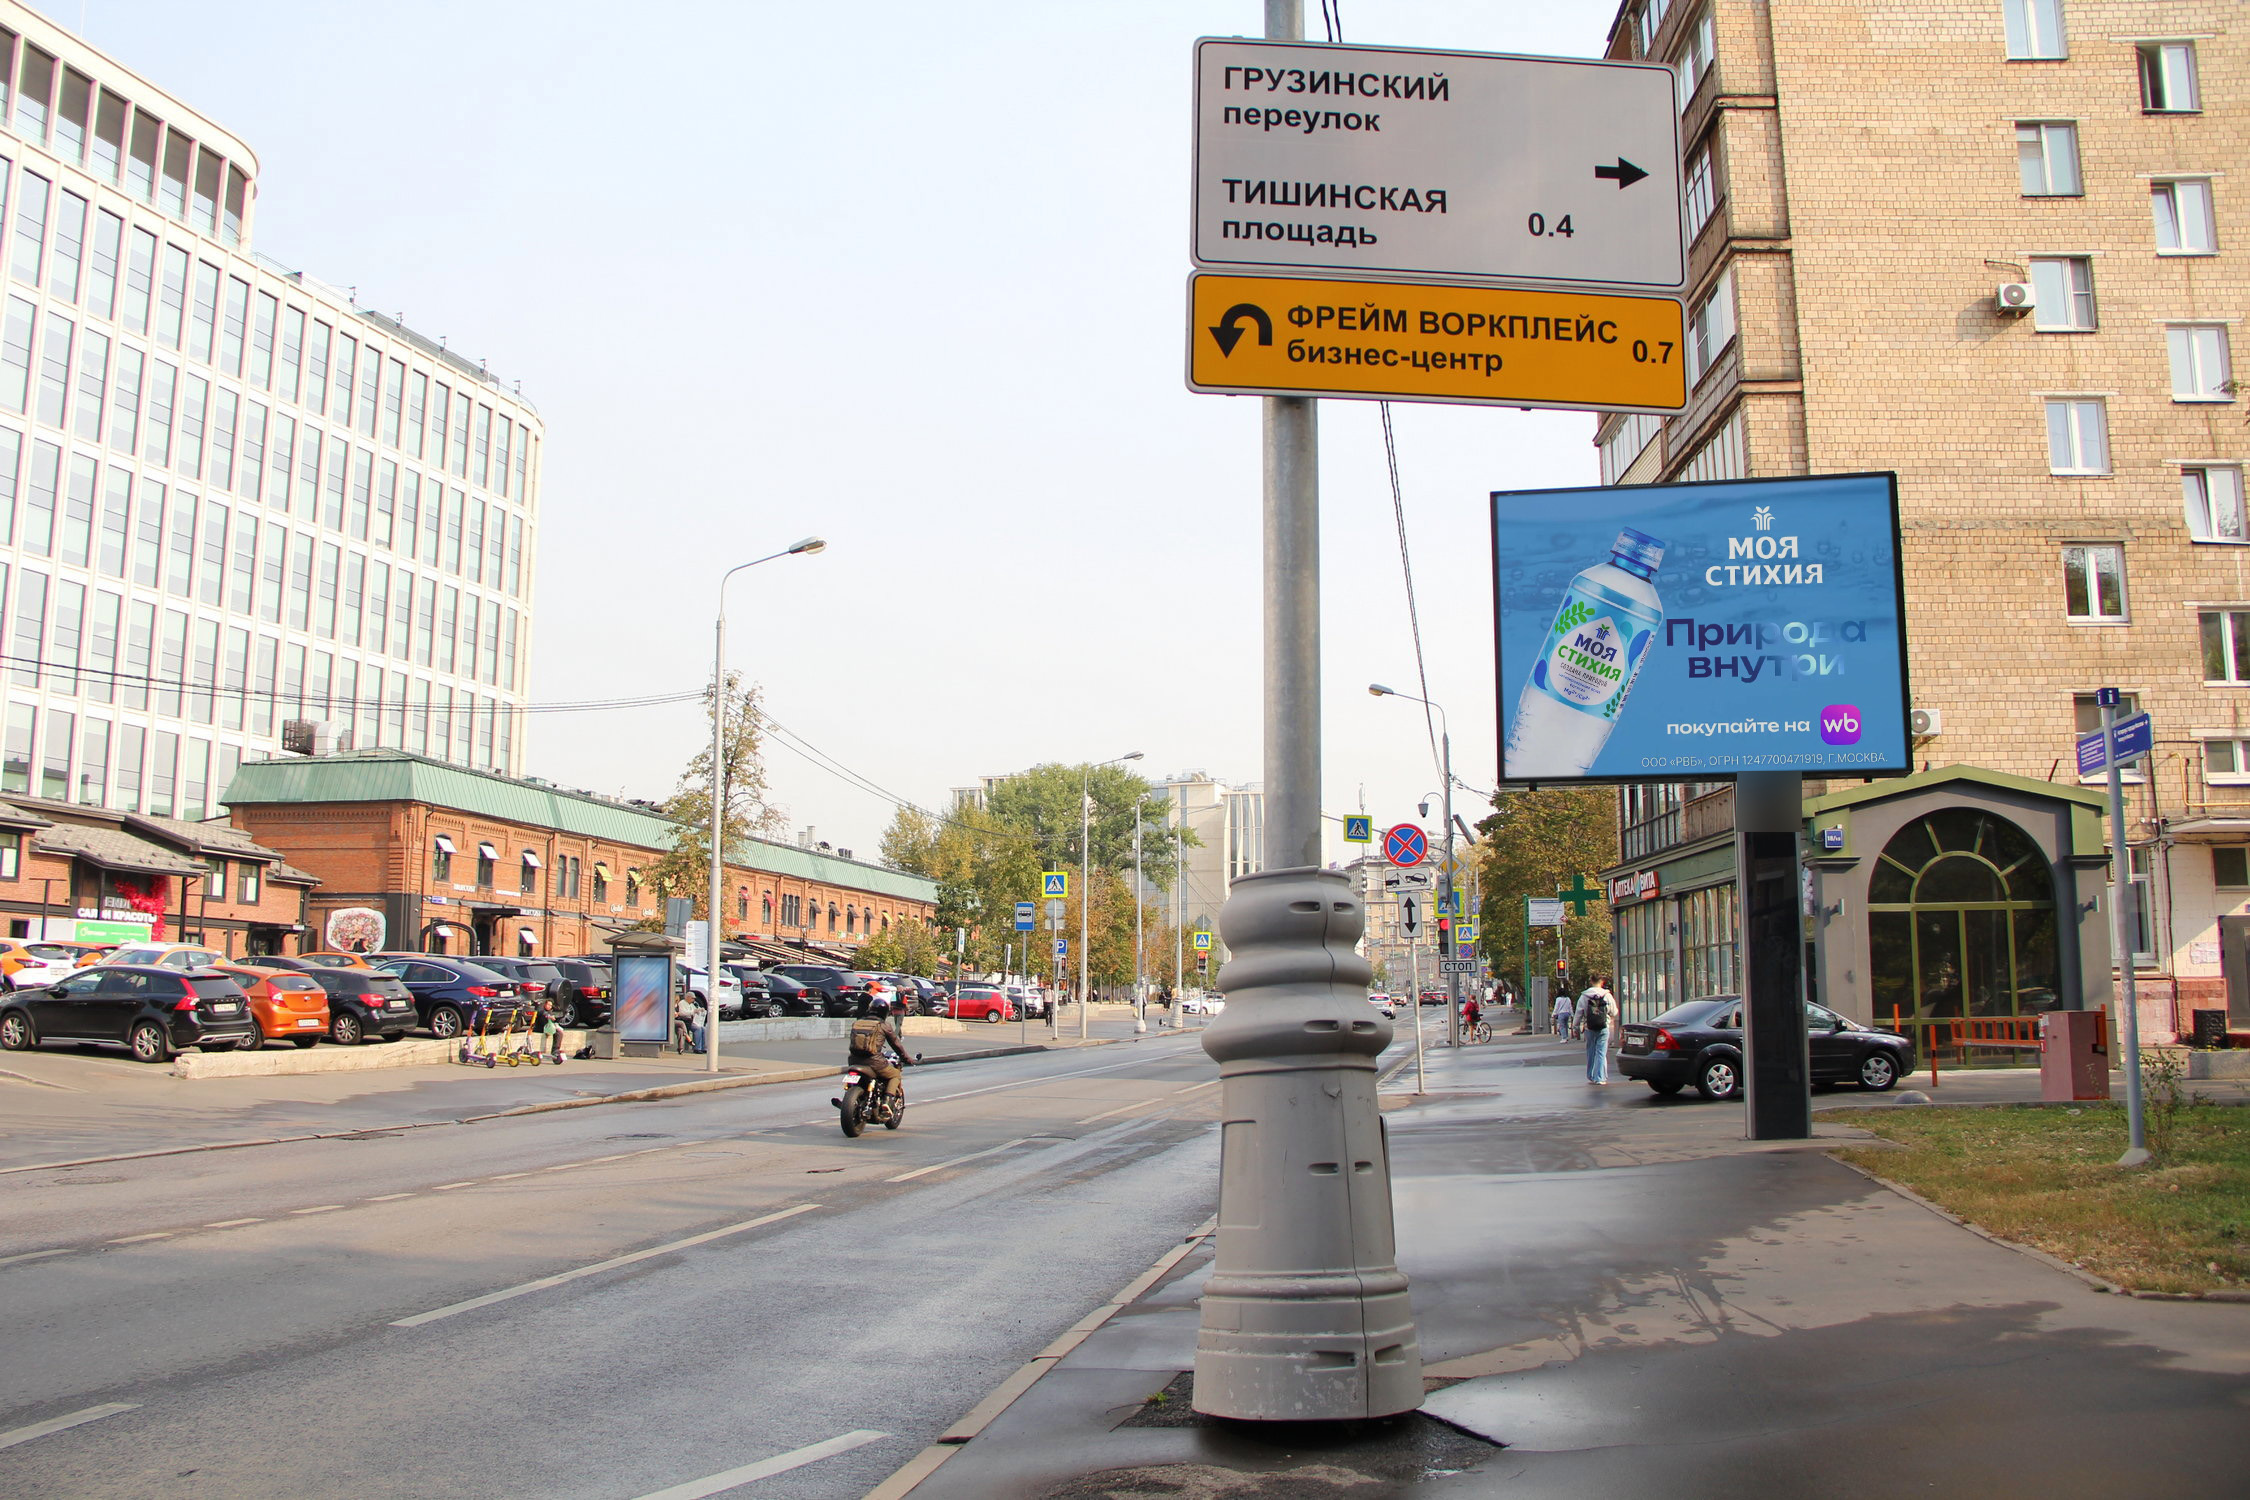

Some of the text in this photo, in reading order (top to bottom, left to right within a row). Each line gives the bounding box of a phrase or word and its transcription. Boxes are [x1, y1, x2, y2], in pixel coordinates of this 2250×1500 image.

[1224, 66, 1449, 102] ГРУЗИНСКИЙ
[1224, 106, 1380, 134] переулок
[1222, 178, 1447, 214] ТИШИНСКАЯ
[1222, 220, 1378, 247] площадь
[1528, 212, 1574, 238] 0.4
[1287, 302, 1618, 344] ФРЕЙМ ВОРКПЛЕЙС
[1287, 338, 1504, 377] бизнес-центр
[1632, 340, 1674, 364] 0.7
[1728, 536, 1799, 560] МОЯ
[1705, 564, 1823, 586] СТИХИЯ
[1574, 633, 1617, 662] МОЯ
[1666, 618, 1866, 651] Природа
[1558, 645, 1621, 681] СТИХИЯ
[1688, 654, 1845, 683] внутри
[1667, 719, 1810, 736] покупайте на
[1823, 713, 1859, 732] wb
[1641, 757, 1667, 768] ООО
[1709, 755, 1739, 766] ОГРН
[77, 907, 112, 920] САЛН
[1444, 962, 1472, 971] СТОП
